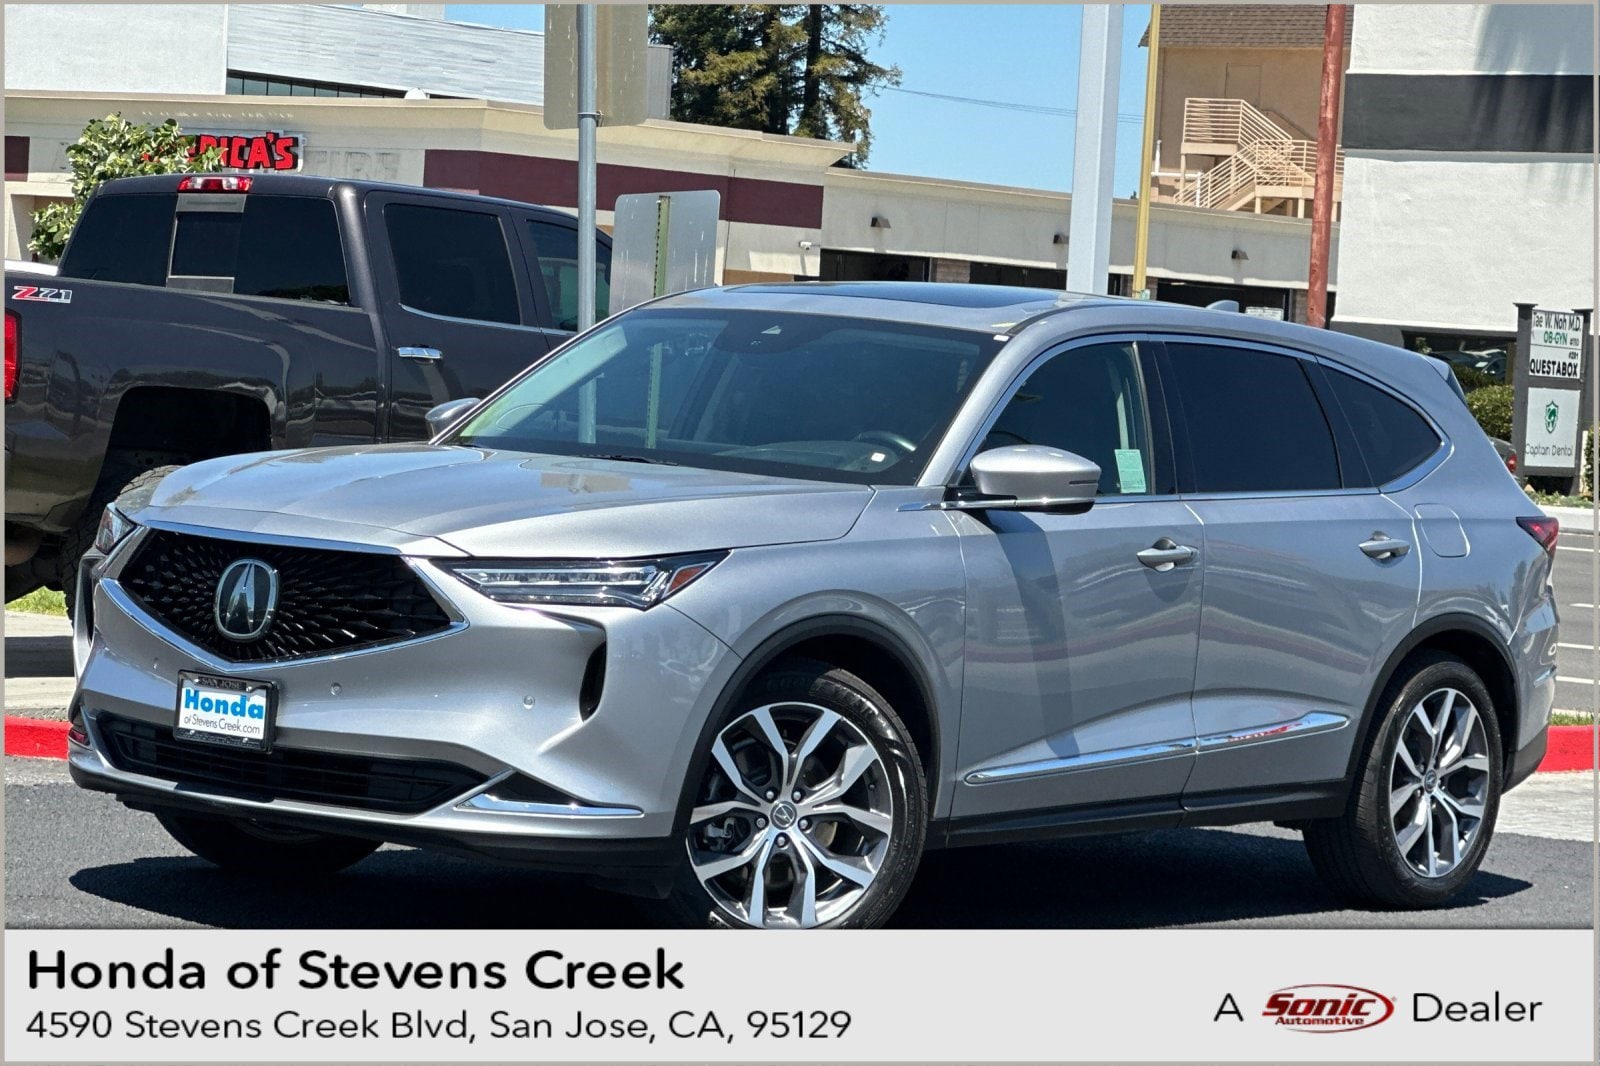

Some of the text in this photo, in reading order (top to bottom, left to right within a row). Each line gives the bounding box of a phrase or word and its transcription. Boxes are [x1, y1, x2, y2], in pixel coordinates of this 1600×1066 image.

[12, 286, 72, 303] Z71
[1543, 330, 1568, 345] OB-GYN
[1529, 359, 1578, 377] QUESTABOX
[1525, 443, 1574, 457] Captain Dental
[184, 688, 264, 720] Honda
[184, 715, 192, 725] of
